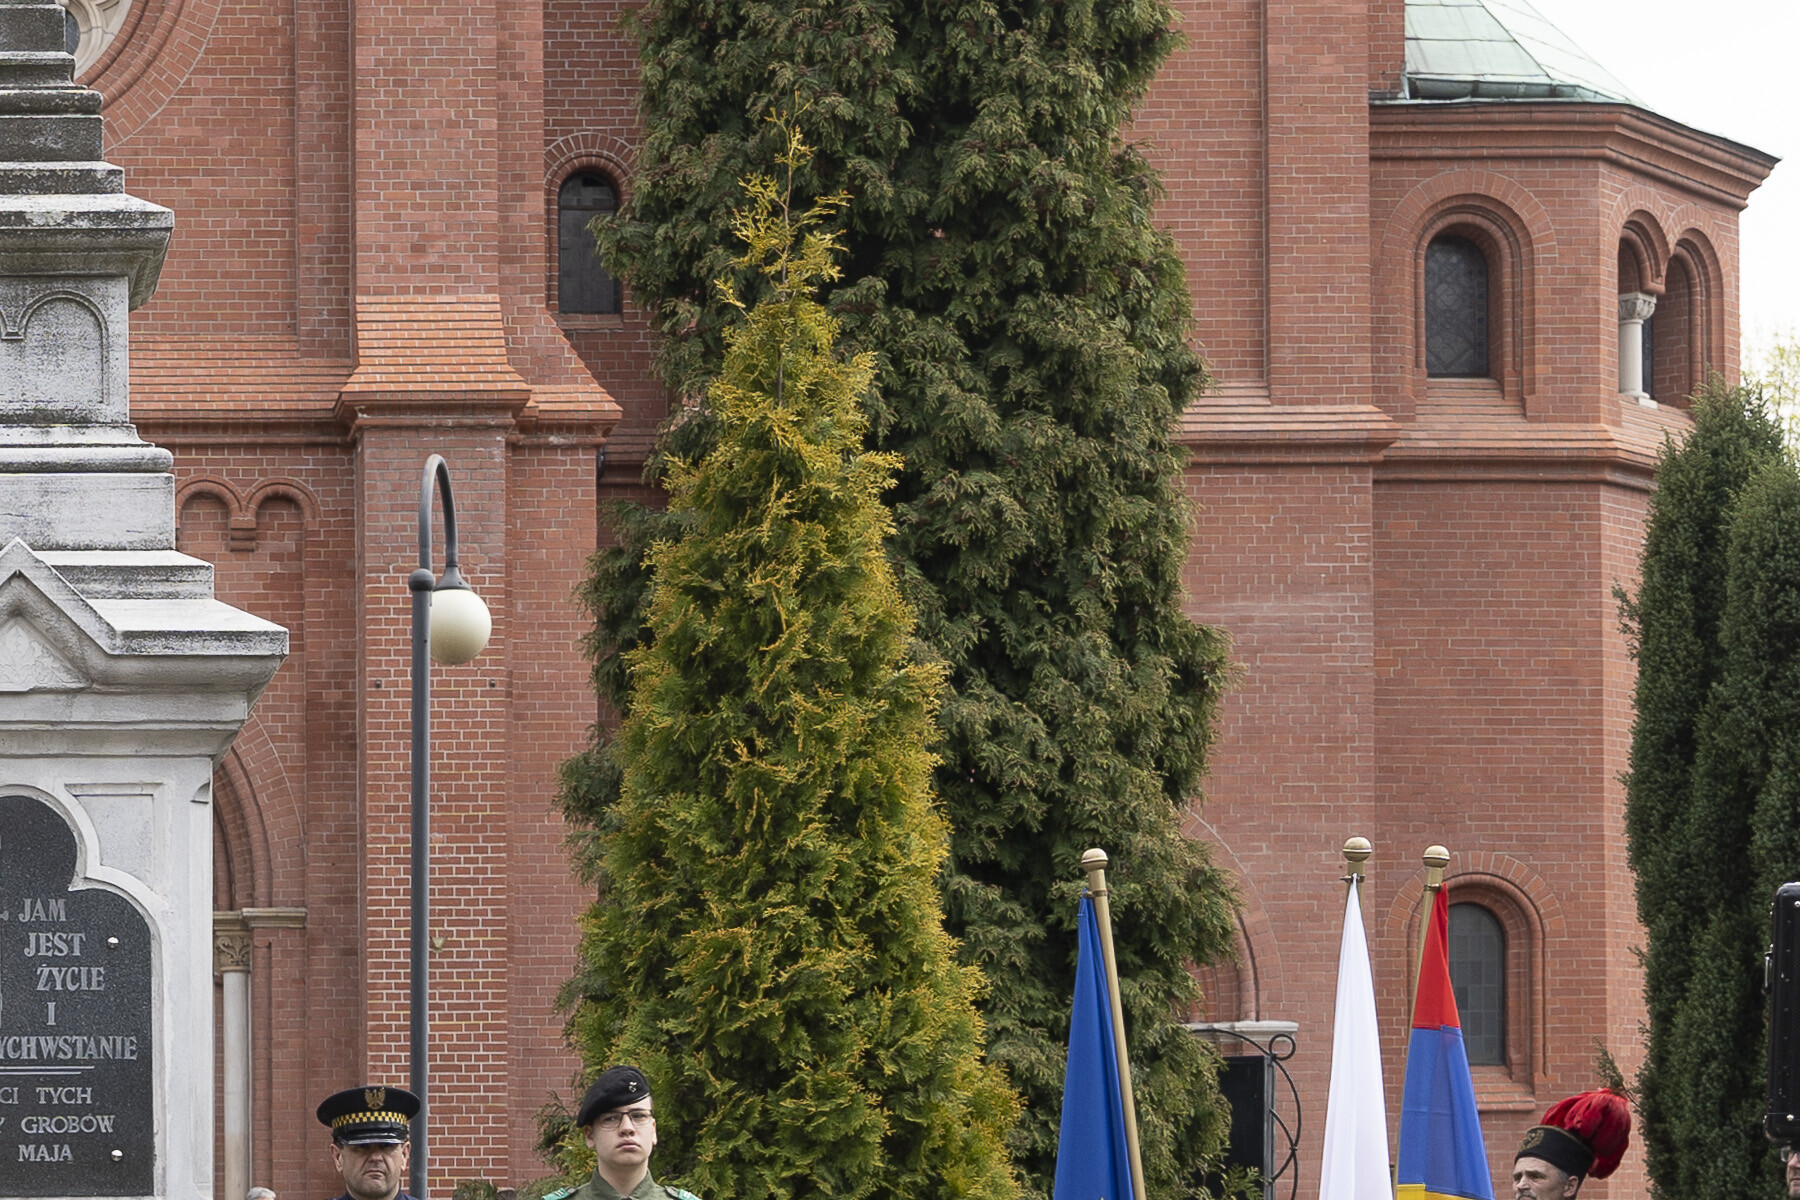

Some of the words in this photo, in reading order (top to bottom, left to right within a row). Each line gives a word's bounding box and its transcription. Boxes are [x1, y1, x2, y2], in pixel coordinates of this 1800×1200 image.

[18, 898, 67, 923] JAM
[23, 932, 86, 957] JEST
[36, 963, 106, 991] ŻYCIE
[46, 1001, 57, 1026] I
[36, 1087, 93, 1104] TYCH
[20, 1113, 116, 1134] GROBÓW
